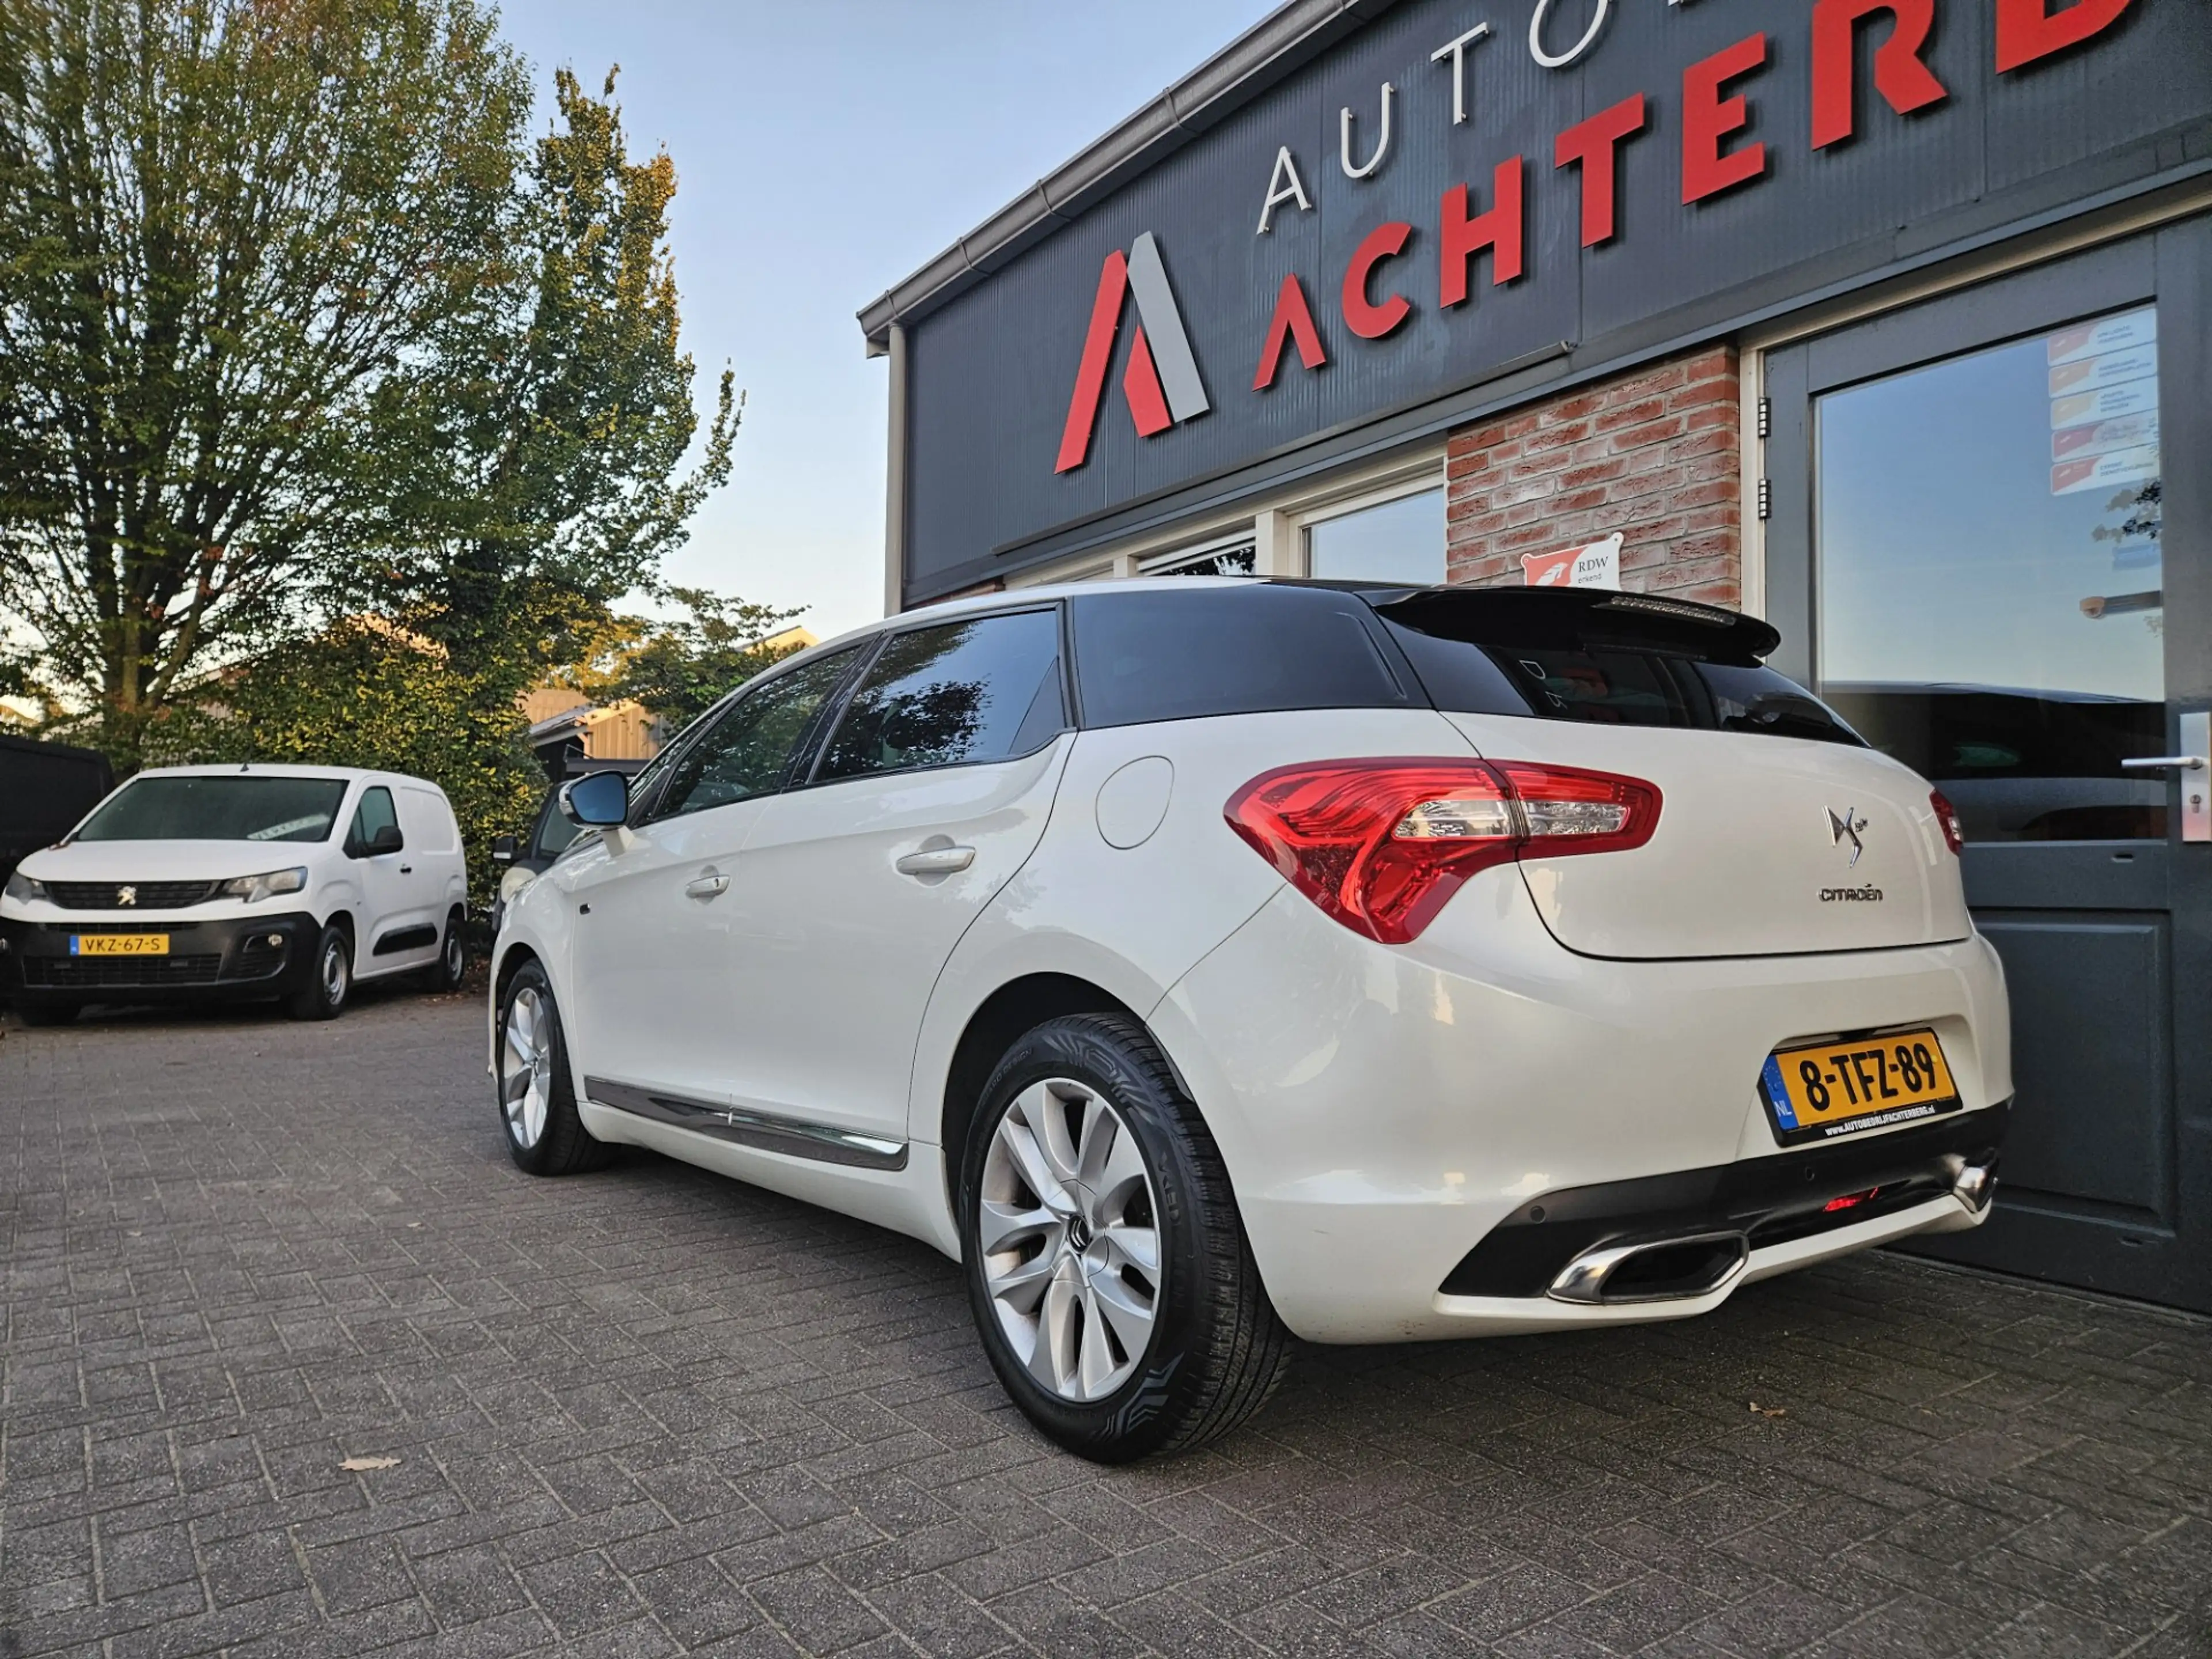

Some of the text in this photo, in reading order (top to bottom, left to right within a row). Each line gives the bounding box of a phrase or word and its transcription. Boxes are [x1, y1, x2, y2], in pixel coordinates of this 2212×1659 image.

[1256, 0, 1685, 236] AUTO
[1578, 555, 1609, 573] RDW
[1578, 573, 1603, 584] erkend
[85, 938, 161, 952] VKZ-67-S
[1800, 1043, 1937, 1112] 8-TFZ-89
[1774, 1100, 1793, 1118] NL
